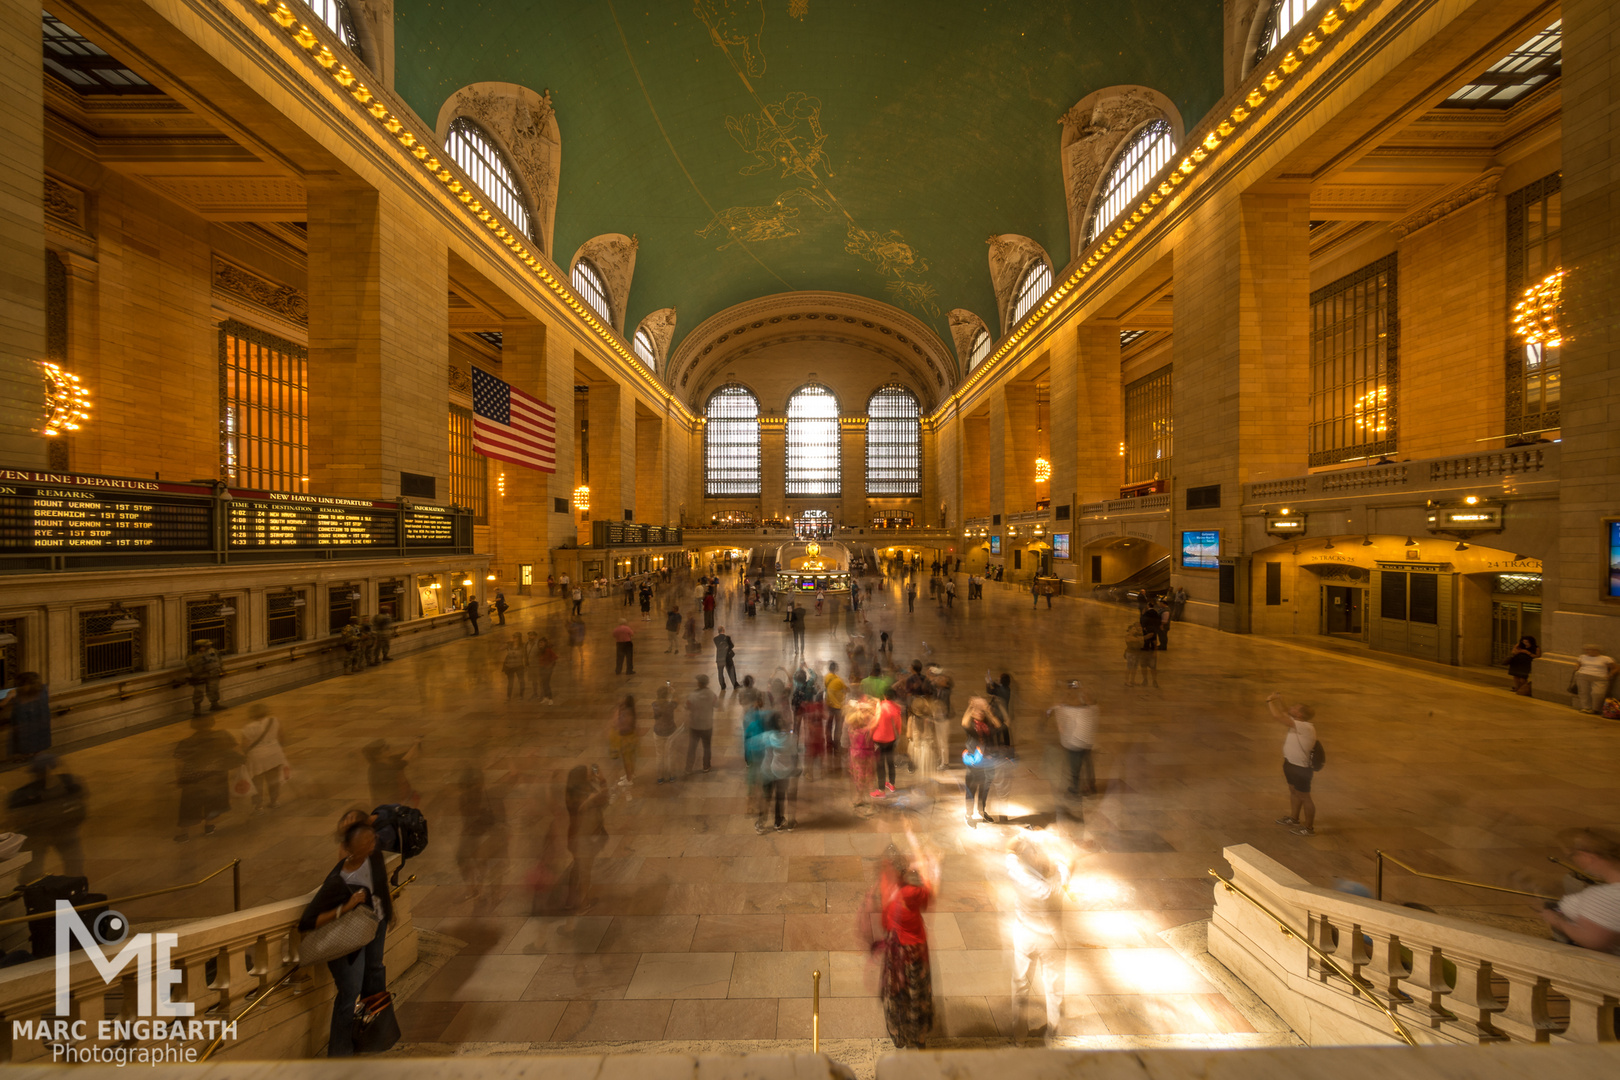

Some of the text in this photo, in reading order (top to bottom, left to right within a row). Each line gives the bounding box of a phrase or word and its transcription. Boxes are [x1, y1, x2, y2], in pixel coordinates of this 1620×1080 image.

[35, 473, 72, 484] LINE
[76, 476, 160, 490] DEPARTURES
[37, 489, 95, 499] REMARKS
[34, 510, 85, 518] GREENWICH
